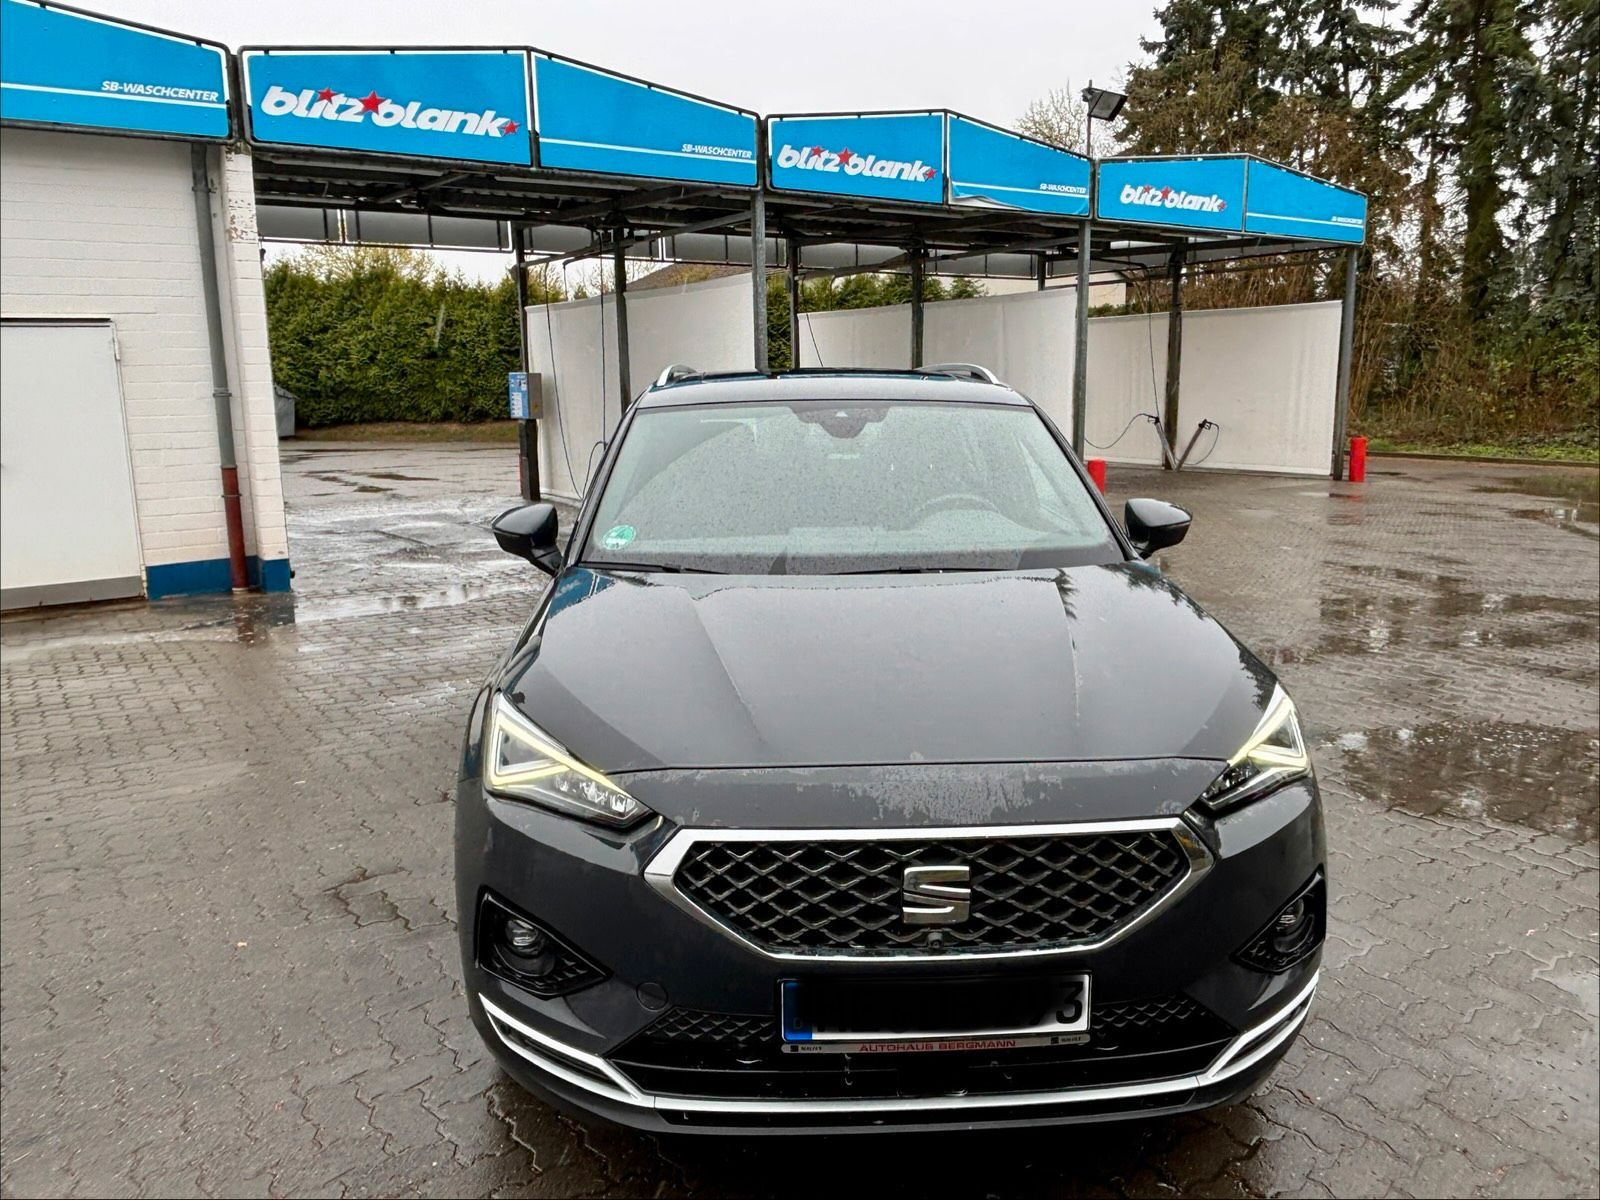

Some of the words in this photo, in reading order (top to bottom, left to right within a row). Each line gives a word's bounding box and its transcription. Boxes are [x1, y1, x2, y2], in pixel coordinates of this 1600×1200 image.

[101, 80, 219, 102] SB-WASCHCENTER
[681, 143, 753, 159] SB-WASCHCENTER
[859, 1043, 934, 1053] AUTOHAUS
[938, 1040, 1016, 1051] BERGMANN
